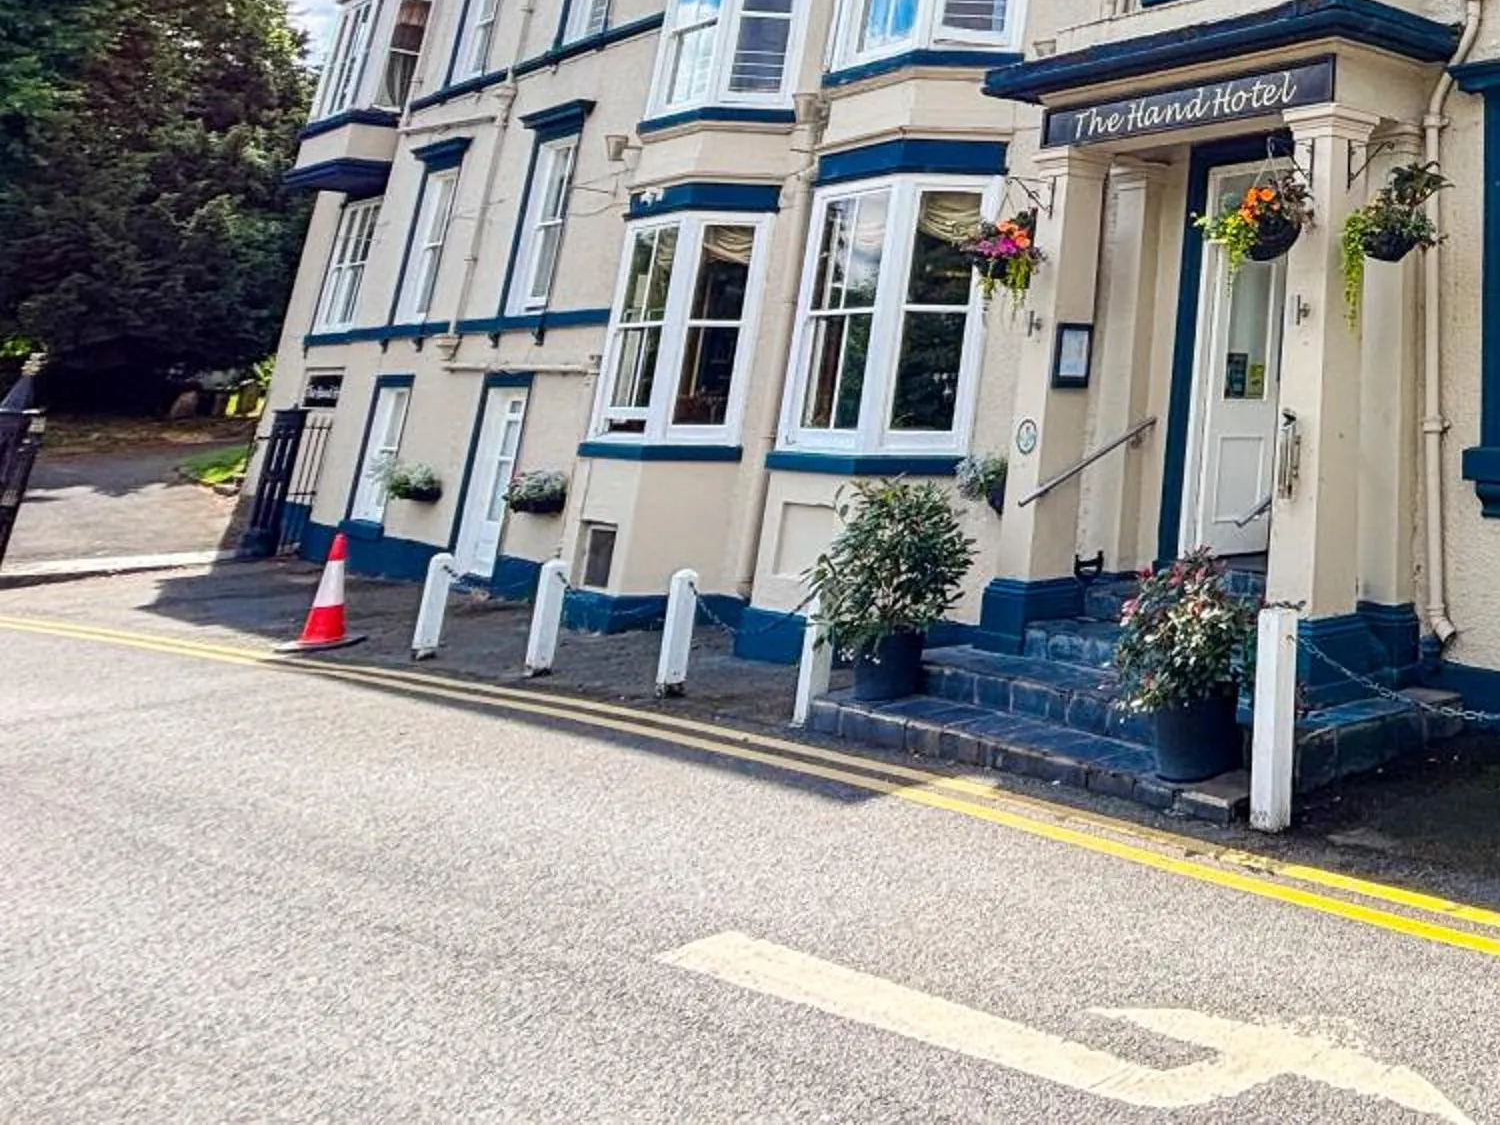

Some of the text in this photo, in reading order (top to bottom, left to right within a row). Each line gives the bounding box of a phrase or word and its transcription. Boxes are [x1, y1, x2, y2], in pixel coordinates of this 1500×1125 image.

[1075, 71, 1297, 139] The Hand Hotel
